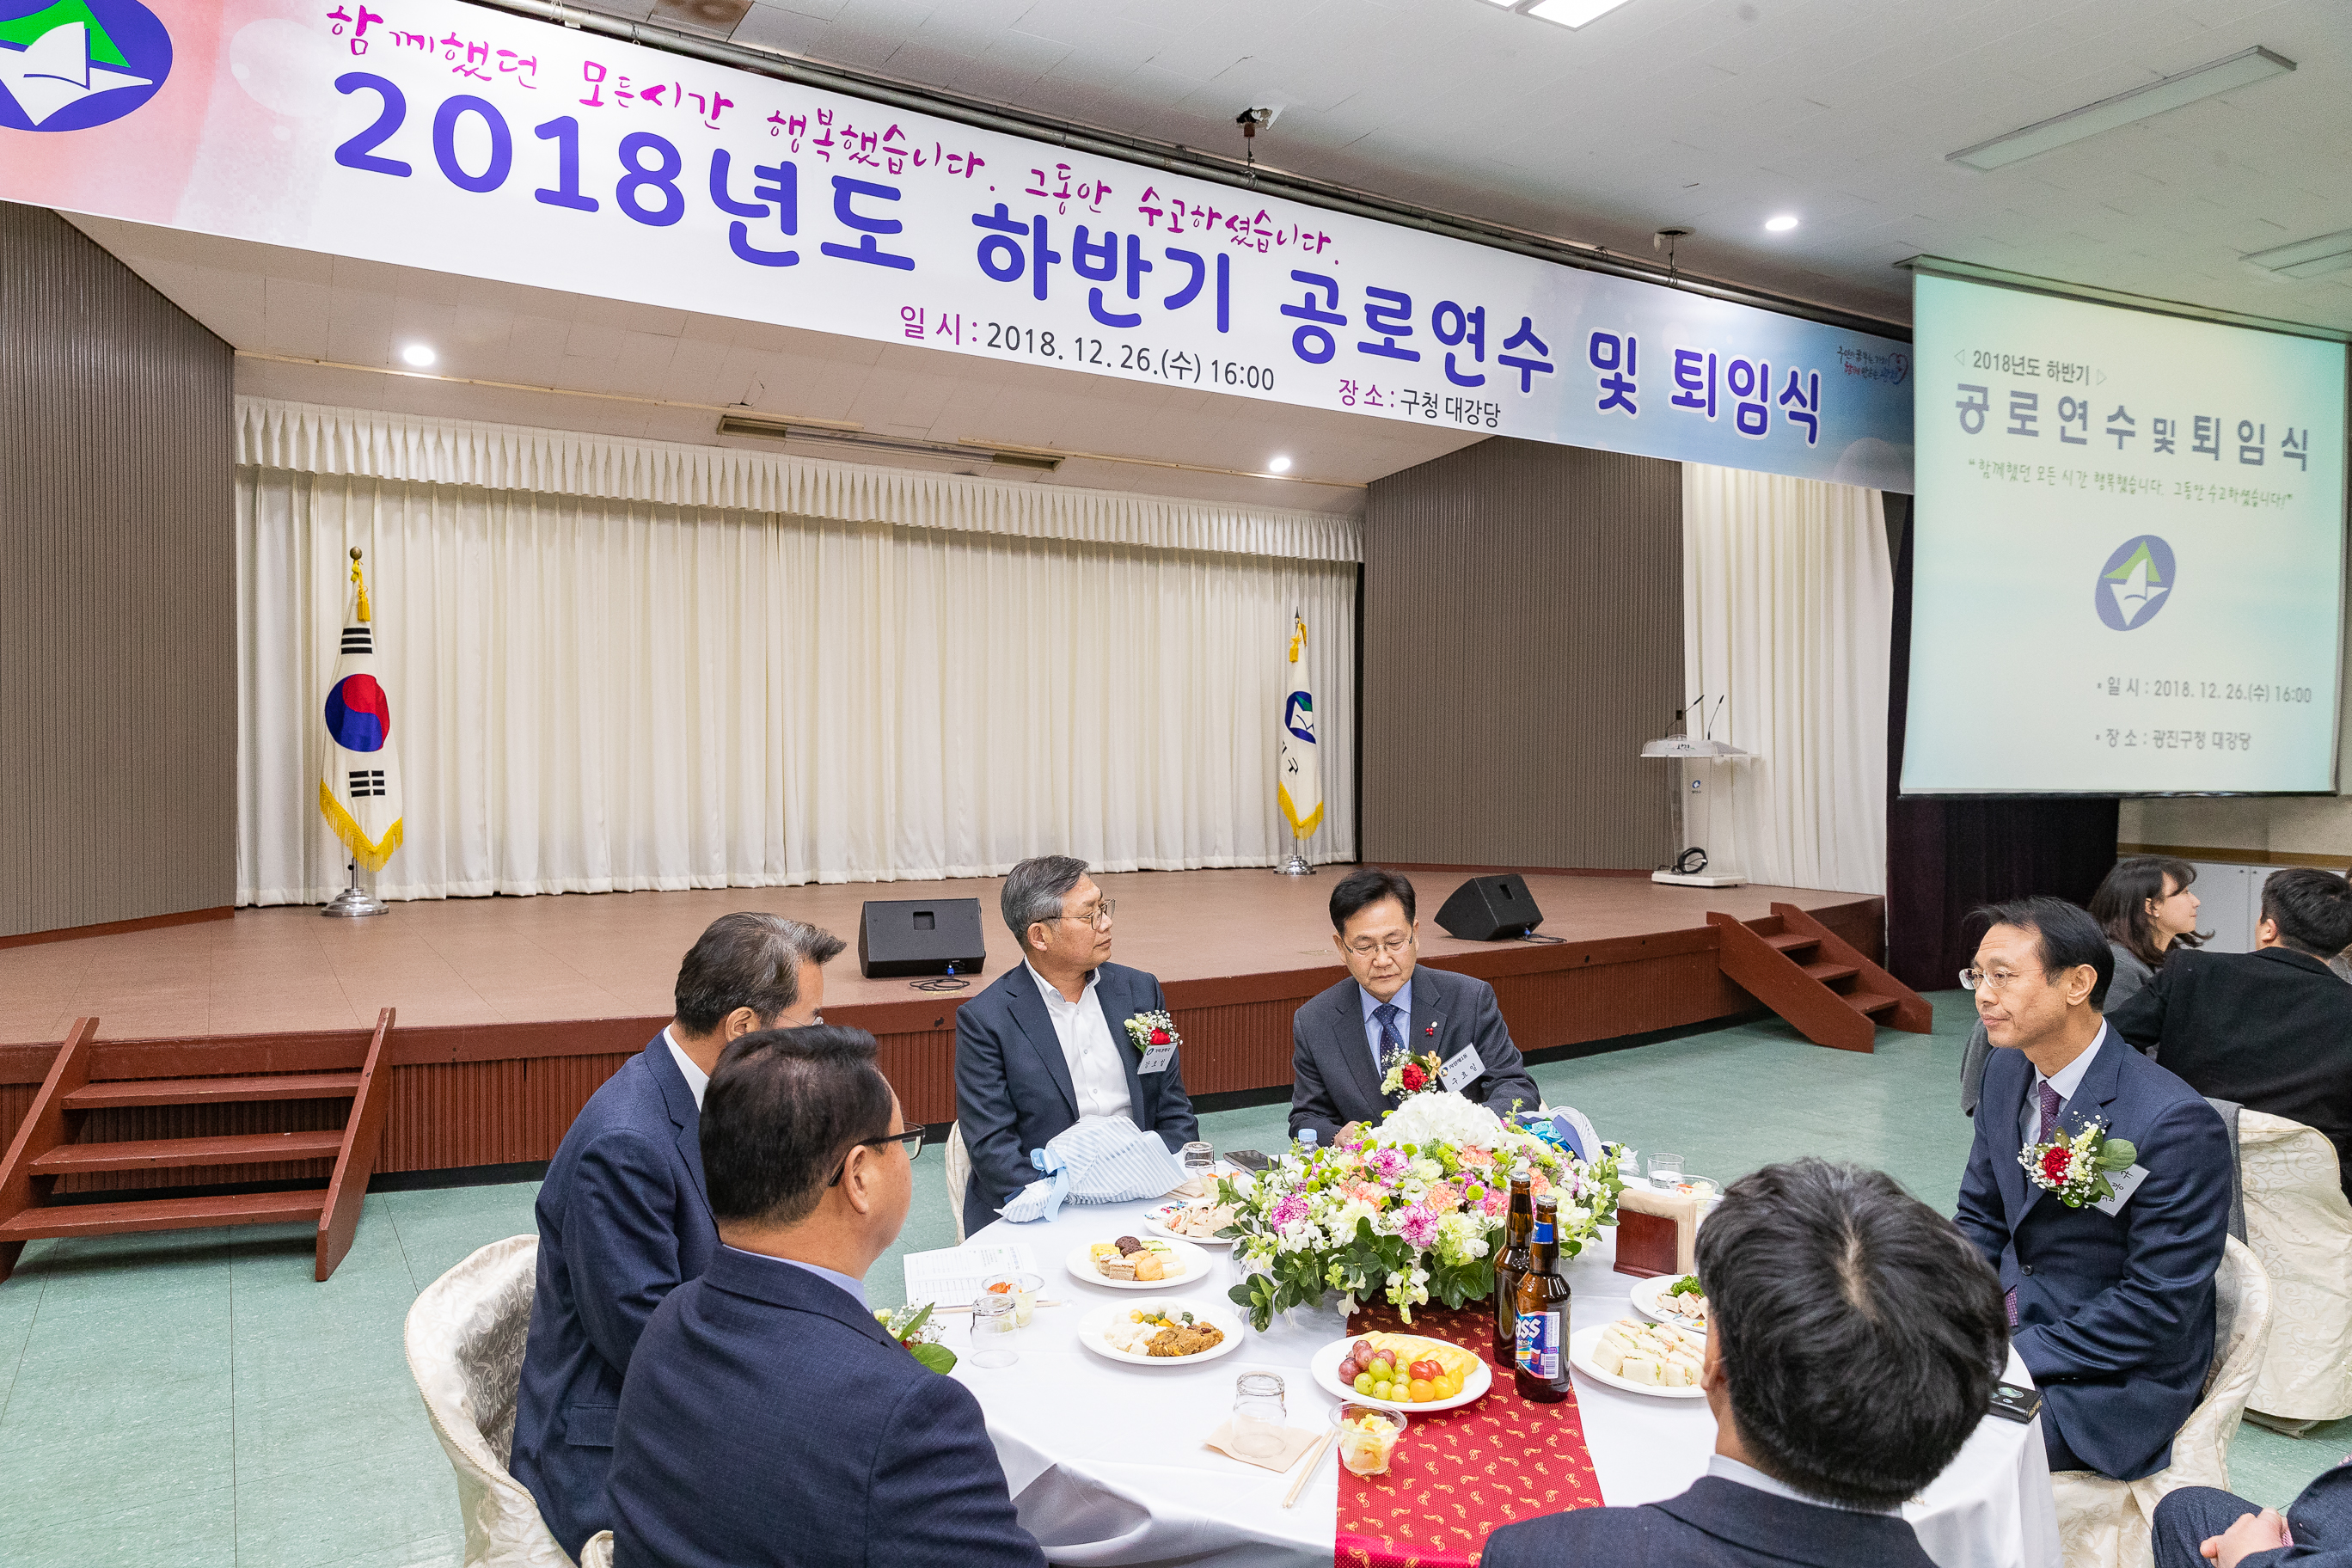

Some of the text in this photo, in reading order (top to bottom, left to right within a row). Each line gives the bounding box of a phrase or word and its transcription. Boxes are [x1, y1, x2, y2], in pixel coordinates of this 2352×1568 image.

[327, 5, 536, 89] 함께했던
[767, 108, 995, 192] 행복했습니다.
[1025, 163, 1112, 214] 그동안
[1138, 187, 1338, 265] 수고하셨습니다.
[334, 72, 1818, 444] 2018년도 하반기 공로연수 및 퇴임식
[1210, 359, 1275, 391] 16:00
[1973, 350, 2089, 386] 2018년도 하반기
[1400, 389, 1439, 420] 구청
[1445, 395, 1501, 429] 대강당
[1955, 383, 2309, 473] 공로연수 및 퇴임식
[2037, 465, 2056, 486] 모든
[2062, 469, 2087, 489] 시간
[2275, 685, 2312, 703] 16:00
[2153, 729, 2206, 750] 광진구청
[2212, 732, 2251, 751] 대강당
[1516, 1317, 1541, 1339] ass
